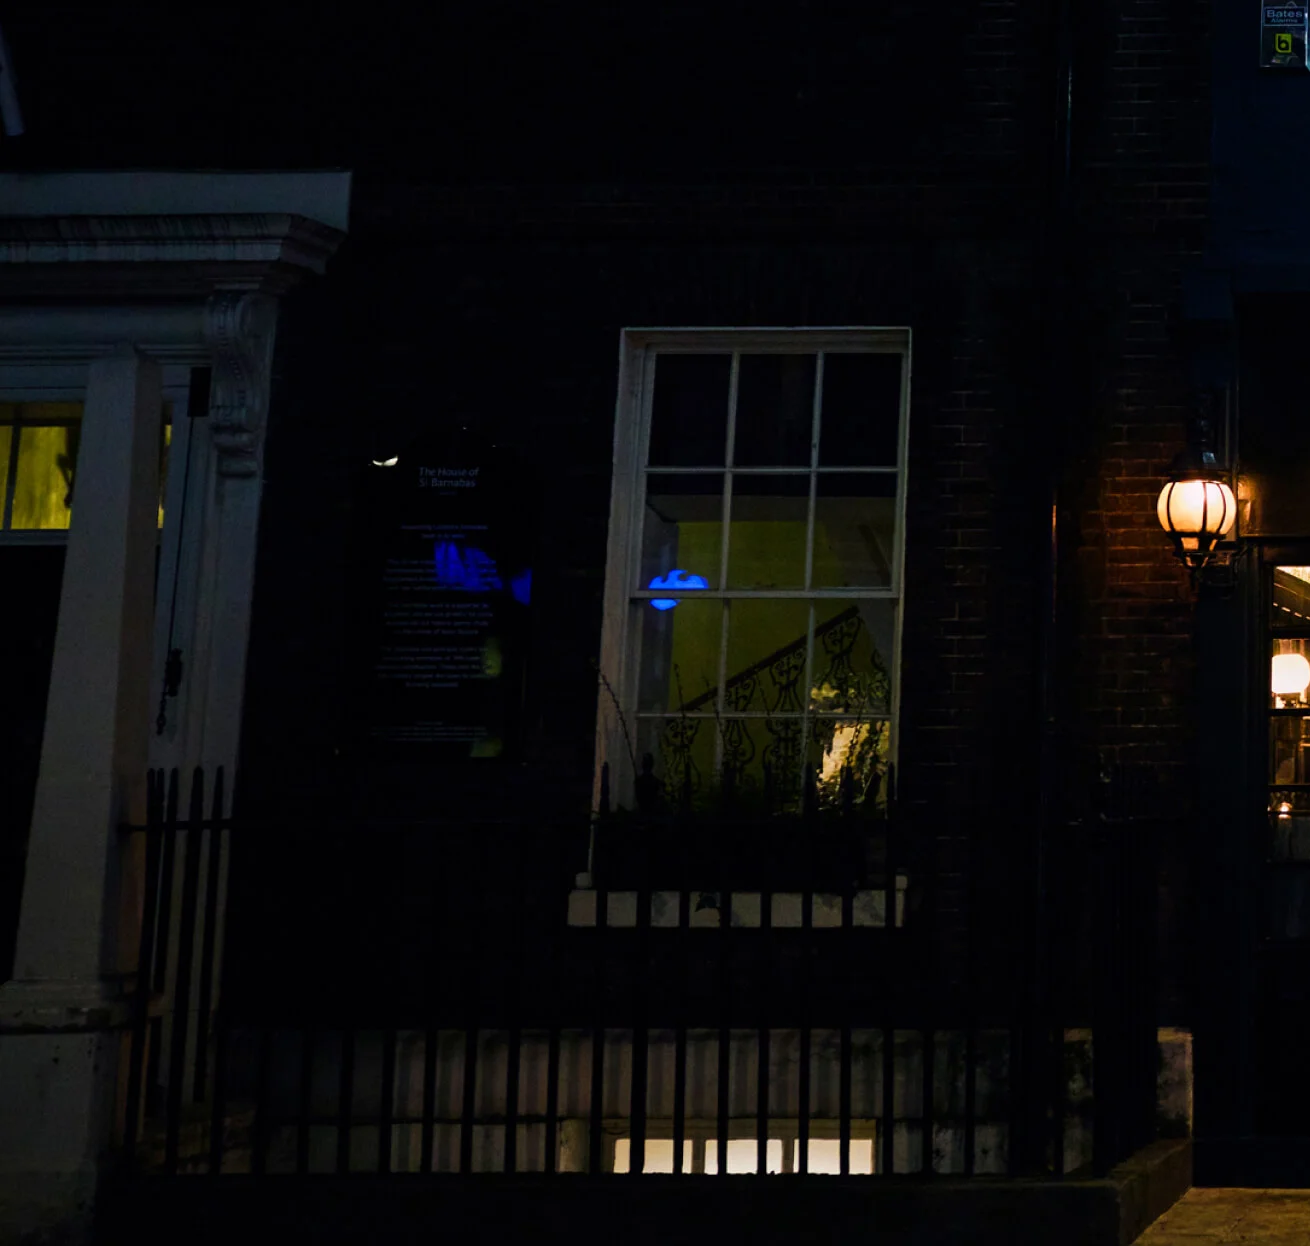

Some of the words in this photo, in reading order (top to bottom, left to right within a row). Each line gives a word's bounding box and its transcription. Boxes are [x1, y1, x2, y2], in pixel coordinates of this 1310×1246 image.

[1266, 9, 1303, 18] Bates
[418, 466, 436, 477] The
[437, 466, 467, 477] House
[468, 466, 481, 477] of
[431, 477, 477, 488] Barnabas
